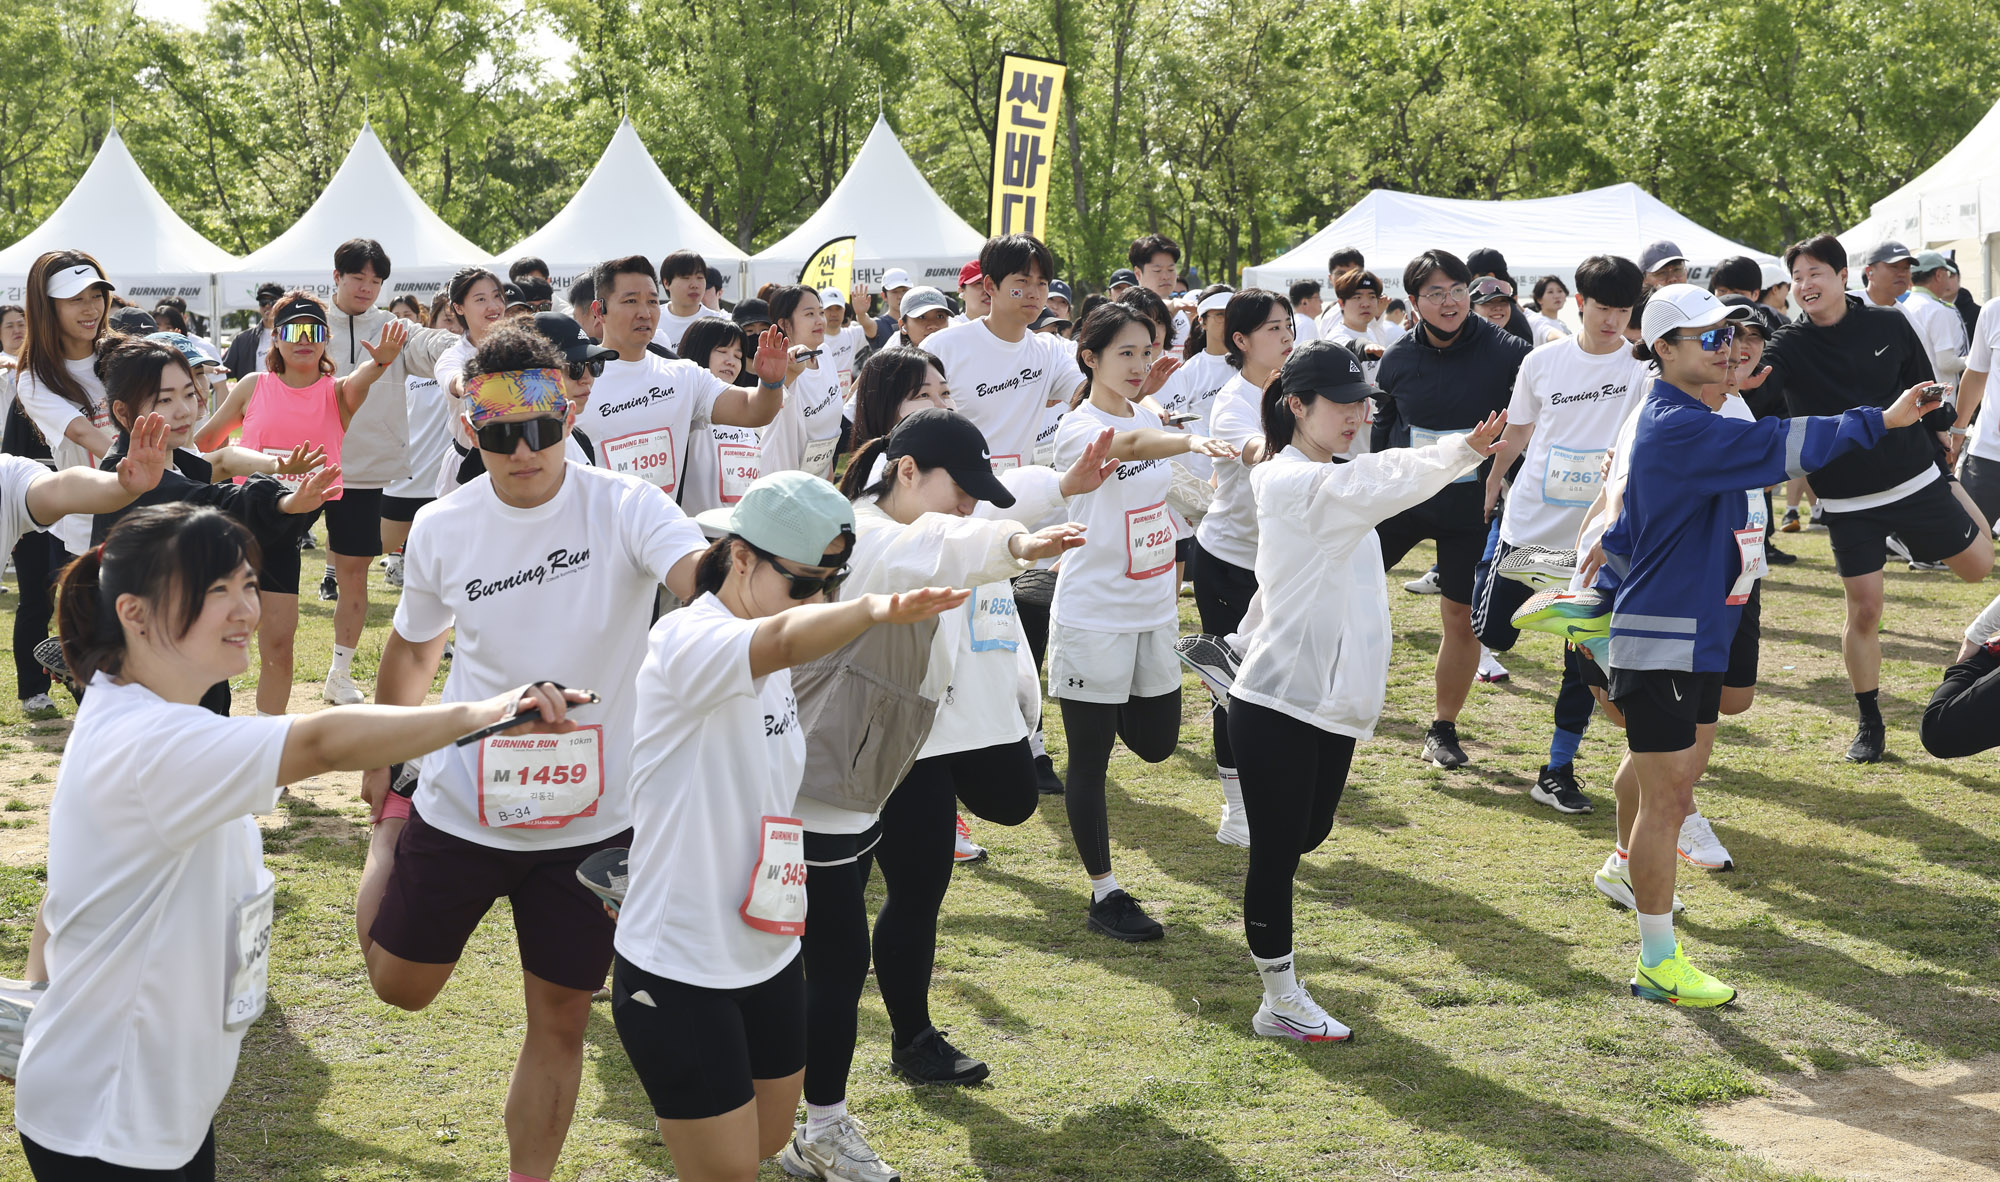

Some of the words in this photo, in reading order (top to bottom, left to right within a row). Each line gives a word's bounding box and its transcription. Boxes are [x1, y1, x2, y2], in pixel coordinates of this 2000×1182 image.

[128, 287, 176, 297] BURNING
[178, 287, 201, 296] RUN
[394, 282, 441, 292] BURNING
[976, 378, 1020, 397] Burning
[1551, 391, 1599, 405] Burning
[1601, 384, 1627, 398] Run
[599, 395, 650, 417] Burning
[649, 386, 675, 401] Run
[803, 397, 831, 418] Burning
[610, 440, 637, 452] BURNING
[618, 462, 628, 473] M
[631, 452, 667, 471] 1309
[1551, 470, 1560, 479] M
[1562, 471, 1601, 484] 7367
[1134, 537, 1145, 548] W
[465, 565, 547, 601] Burning
[547, 548, 591, 574] Run
[490, 739, 535, 748] BURNING
[536, 739, 559, 748] RUN
[569, 737, 592, 746] 10km
[493, 770, 511, 782] M
[517, 763, 587, 786] 1459
[498, 806, 531, 822] B-34
[767, 865, 781, 880] W
